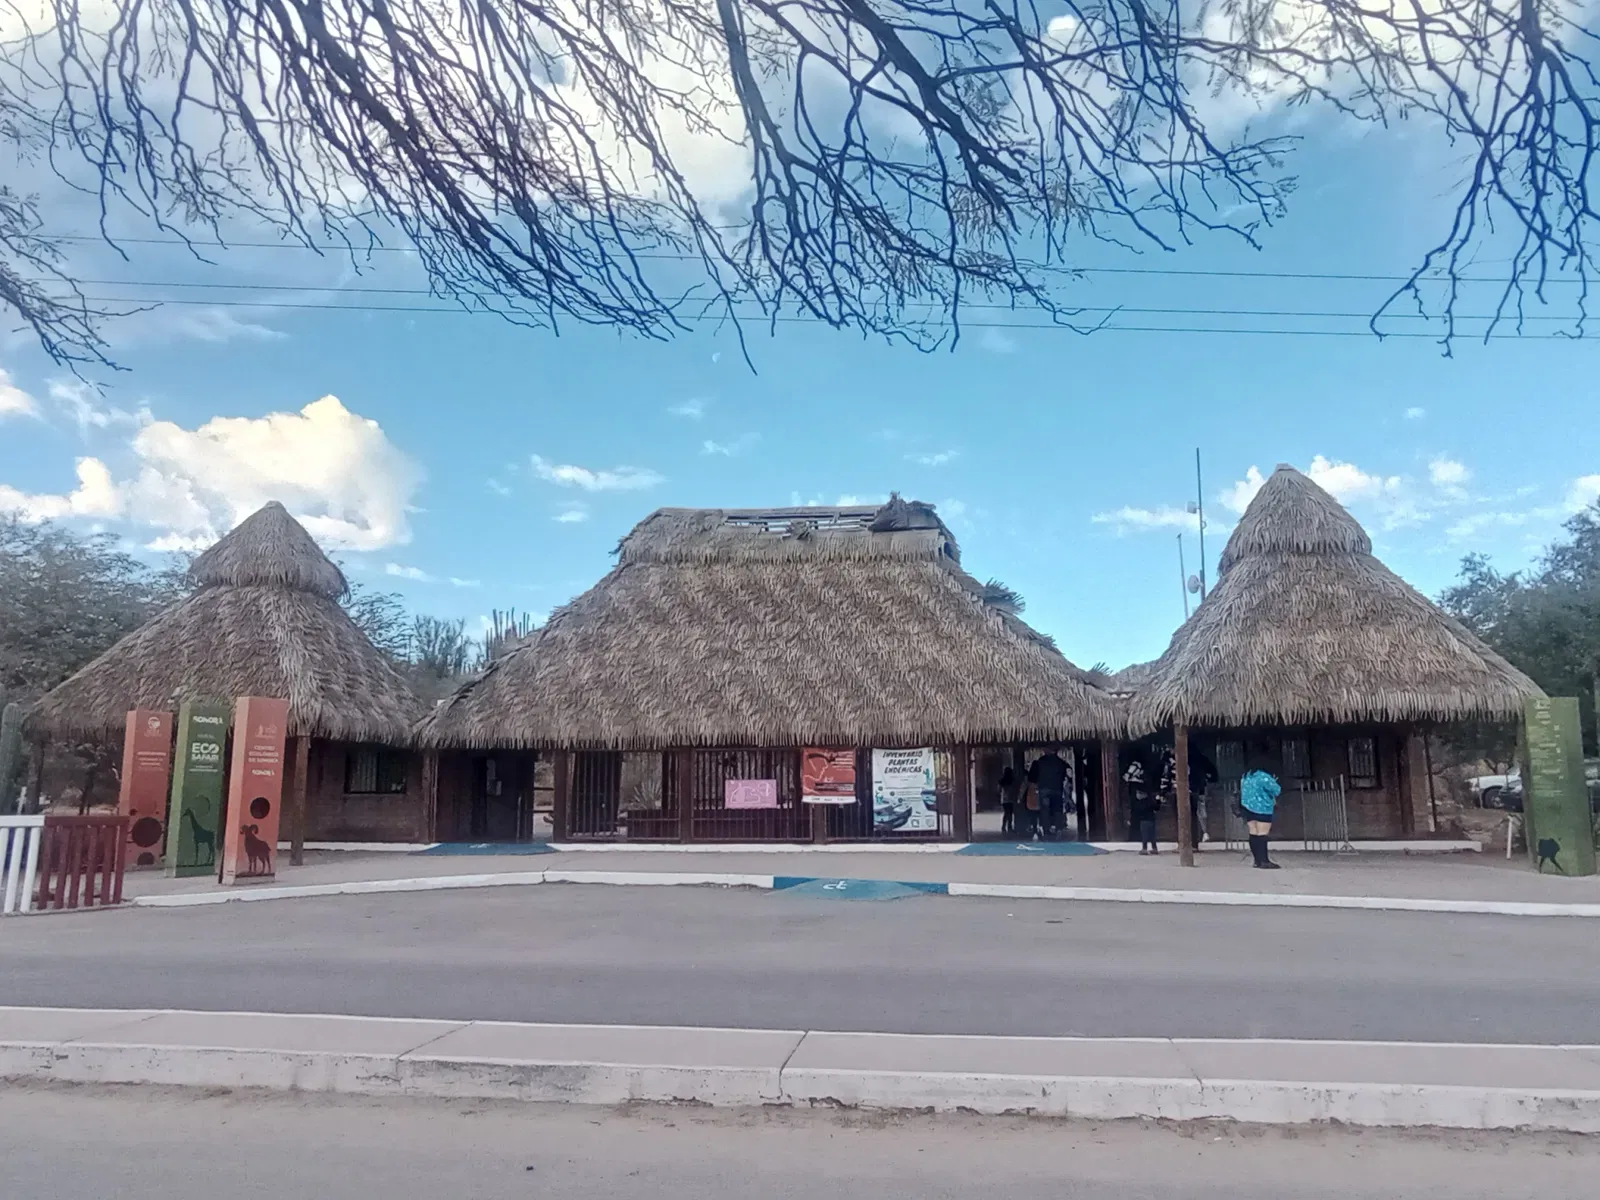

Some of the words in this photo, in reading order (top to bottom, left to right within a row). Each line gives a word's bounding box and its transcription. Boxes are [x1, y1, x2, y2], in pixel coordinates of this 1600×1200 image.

[192, 743, 219, 753] ECO
[882, 751, 923, 759] INVENTARIO
[888, 758, 918, 766] PLANTAS
